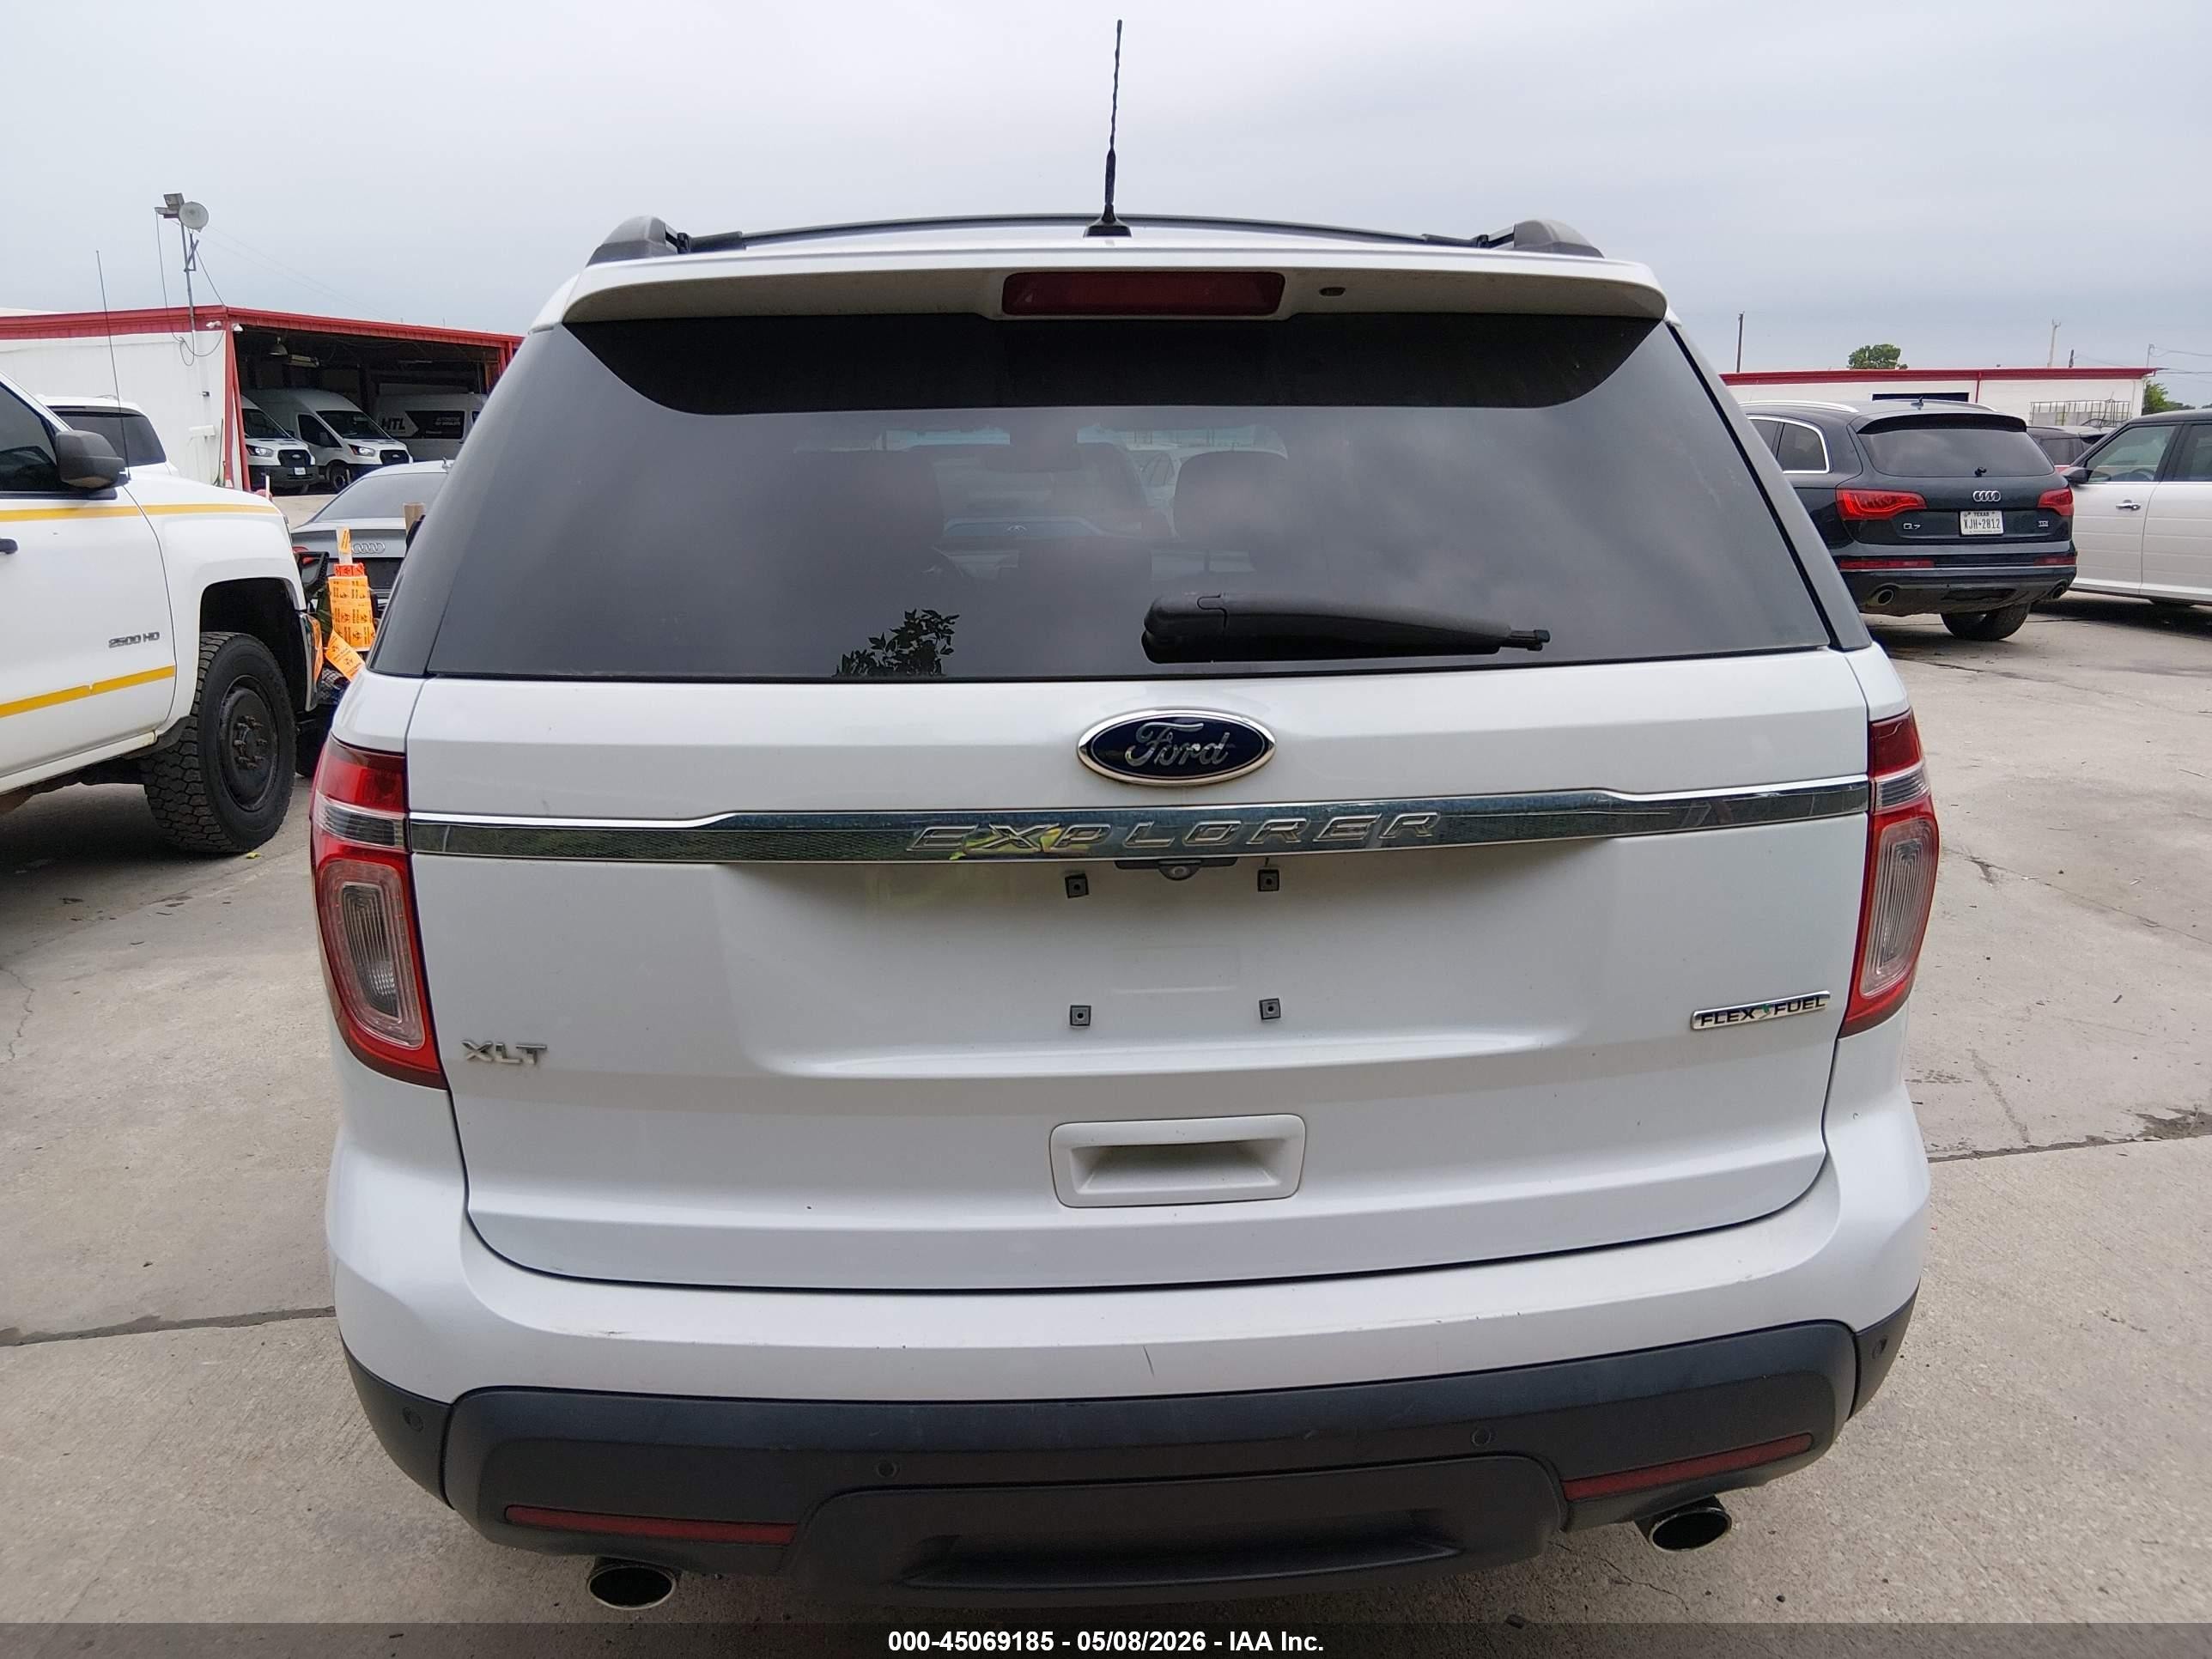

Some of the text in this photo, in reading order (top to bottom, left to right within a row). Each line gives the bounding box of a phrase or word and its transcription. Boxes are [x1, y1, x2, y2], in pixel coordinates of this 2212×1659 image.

[108, 631, 161, 648] 2500 HD
[1124, 722, 1231, 767] Ford
[905, 811, 1443, 852] EXPLORER
[1700, 996, 1826, 1027] FLEX FUEL
[461, 1040, 548, 1065] XLT
